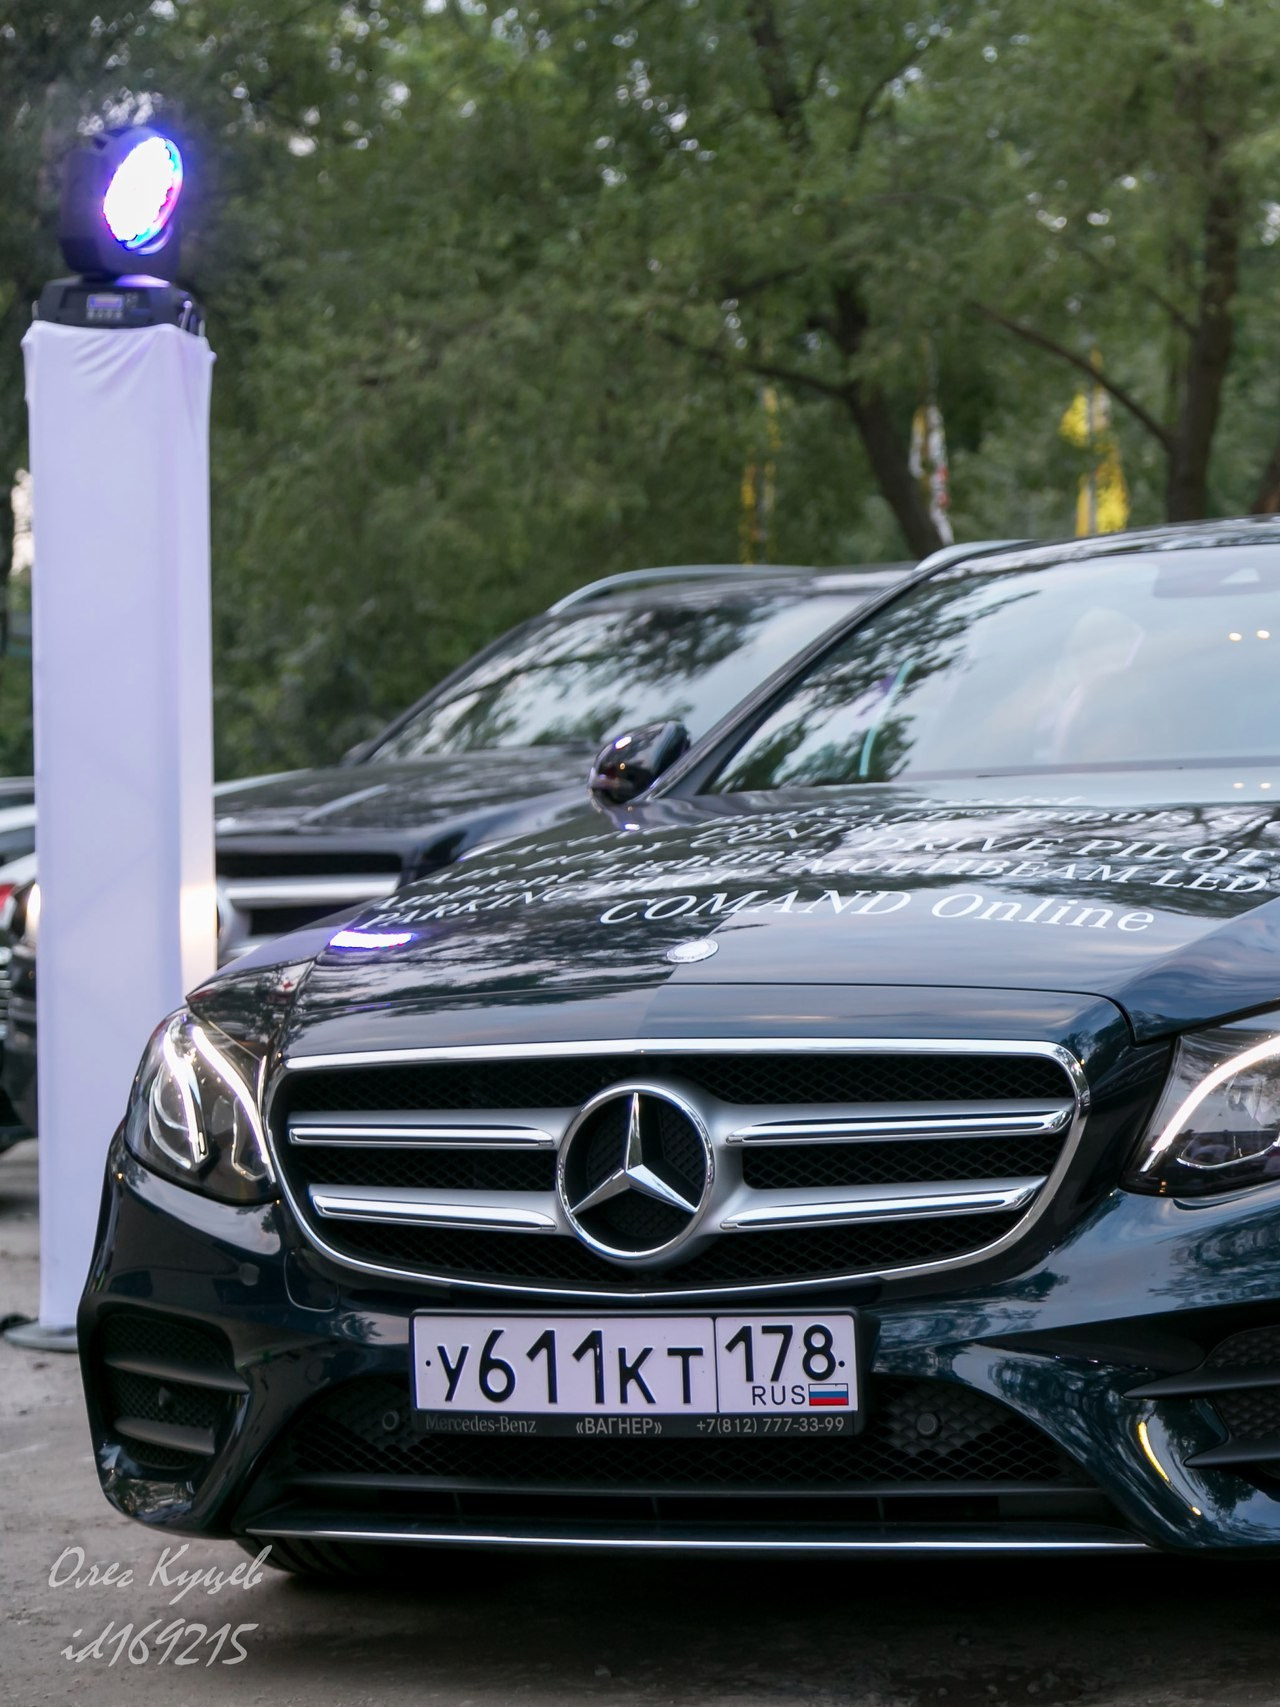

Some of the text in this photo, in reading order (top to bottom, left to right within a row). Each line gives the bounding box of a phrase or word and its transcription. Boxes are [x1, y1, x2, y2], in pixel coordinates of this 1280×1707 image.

[587, 847, 826, 878] Lighting
[856, 836, 1277, 867] DRIVE PILOT
[794, 858, 1268, 893] MULTIBEAM LED
[353, 885, 584, 930] PARKING
[600, 889, 1155, 932] COMAND Online
[725, 1324, 838, 1383] 178
[752, 1386, 806, 1406] RUS
[425, 1416, 537, 1434] Mercedes-Benz
[575, 1418, 663, 1435] «ВАГНЕР»
[696, 1417, 845, 1434] +7(812) 777-33-99
